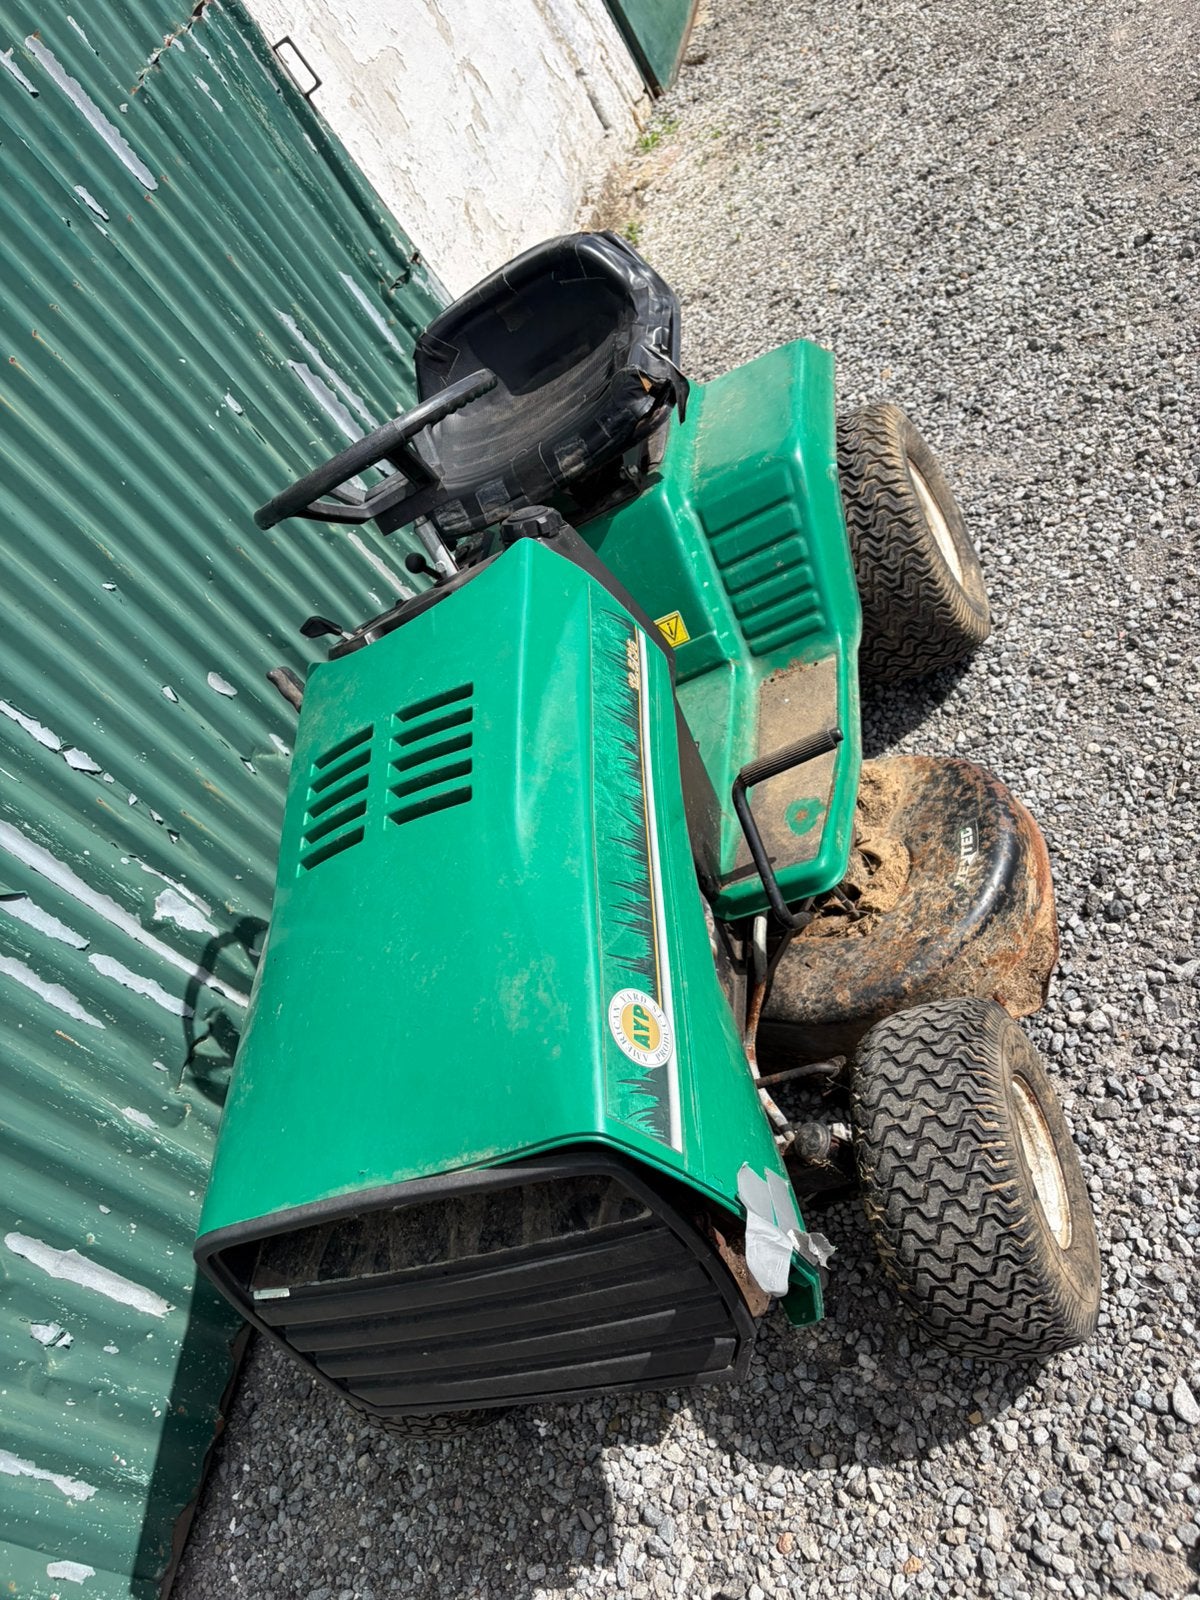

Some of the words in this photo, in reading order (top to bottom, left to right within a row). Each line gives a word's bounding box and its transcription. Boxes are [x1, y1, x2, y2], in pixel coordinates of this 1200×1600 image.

[620, 993, 647, 1004] YARD
[613, 1007, 648, 1062] AMERICAN
[632, 1004, 651, 1050] AYP
